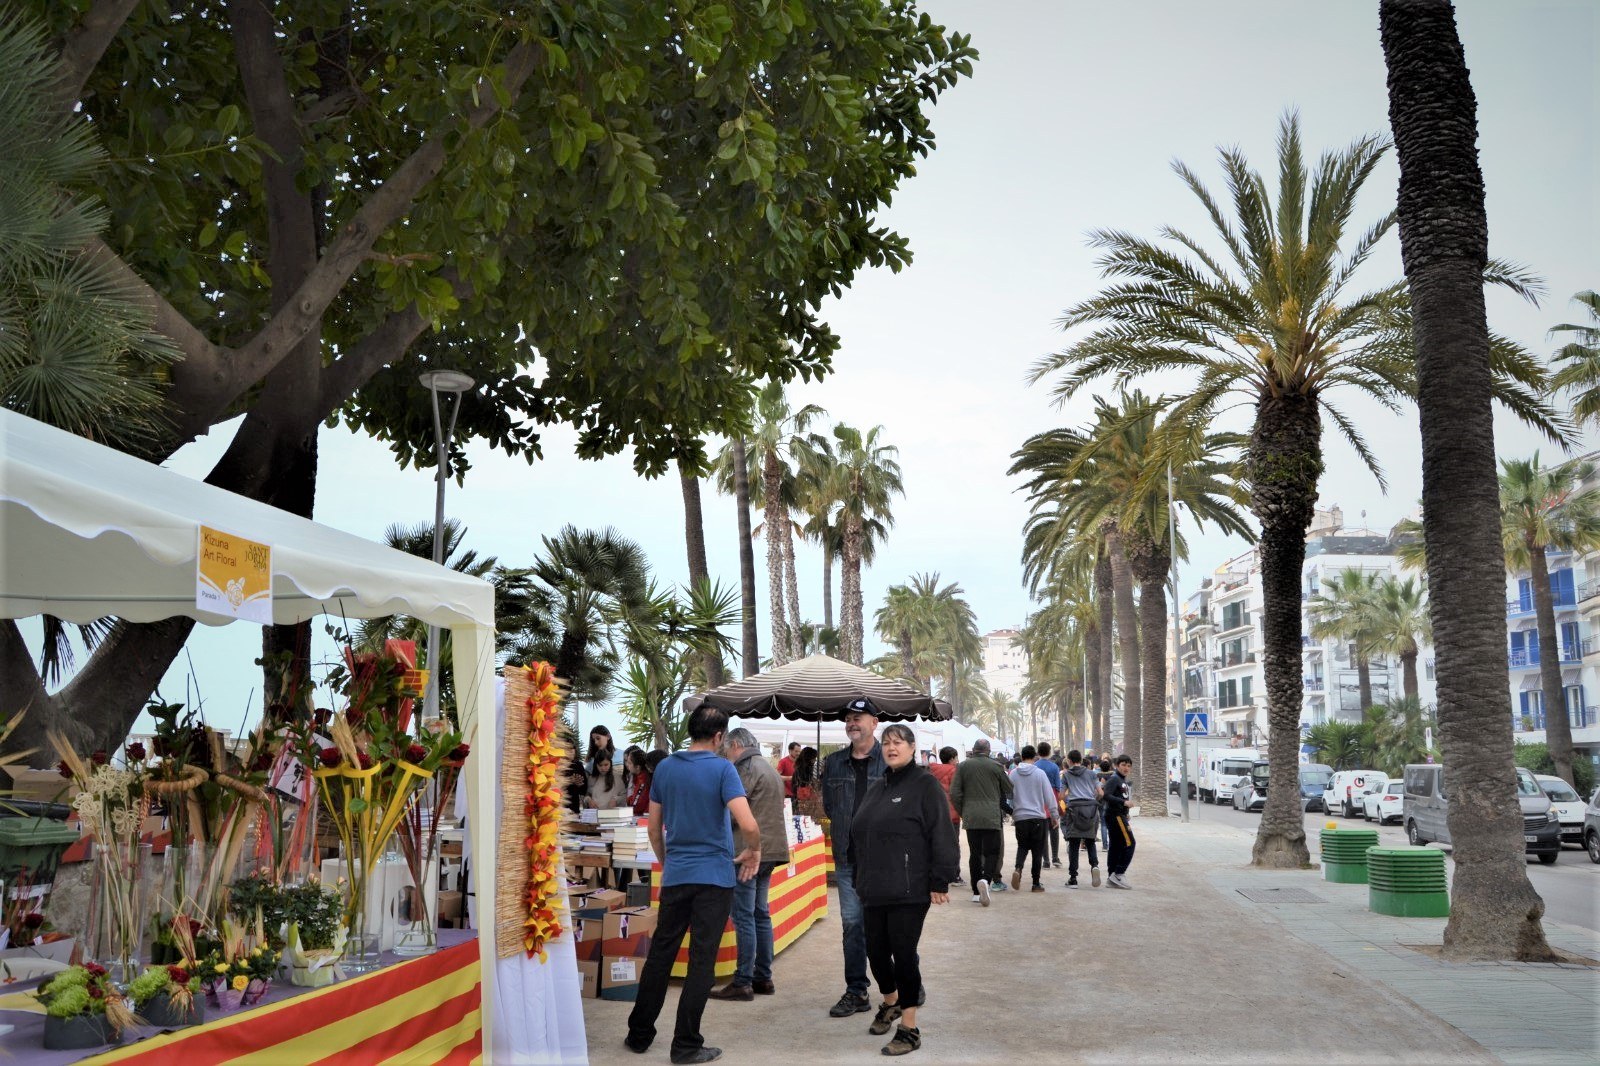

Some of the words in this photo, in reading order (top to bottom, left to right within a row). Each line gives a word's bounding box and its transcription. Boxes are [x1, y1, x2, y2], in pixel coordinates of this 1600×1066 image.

[204, 533, 229, 549] Kizuna
[203, 549, 214, 561] Art
[216, 552, 237, 567] Floral
[248, 544, 268, 559] SANT
